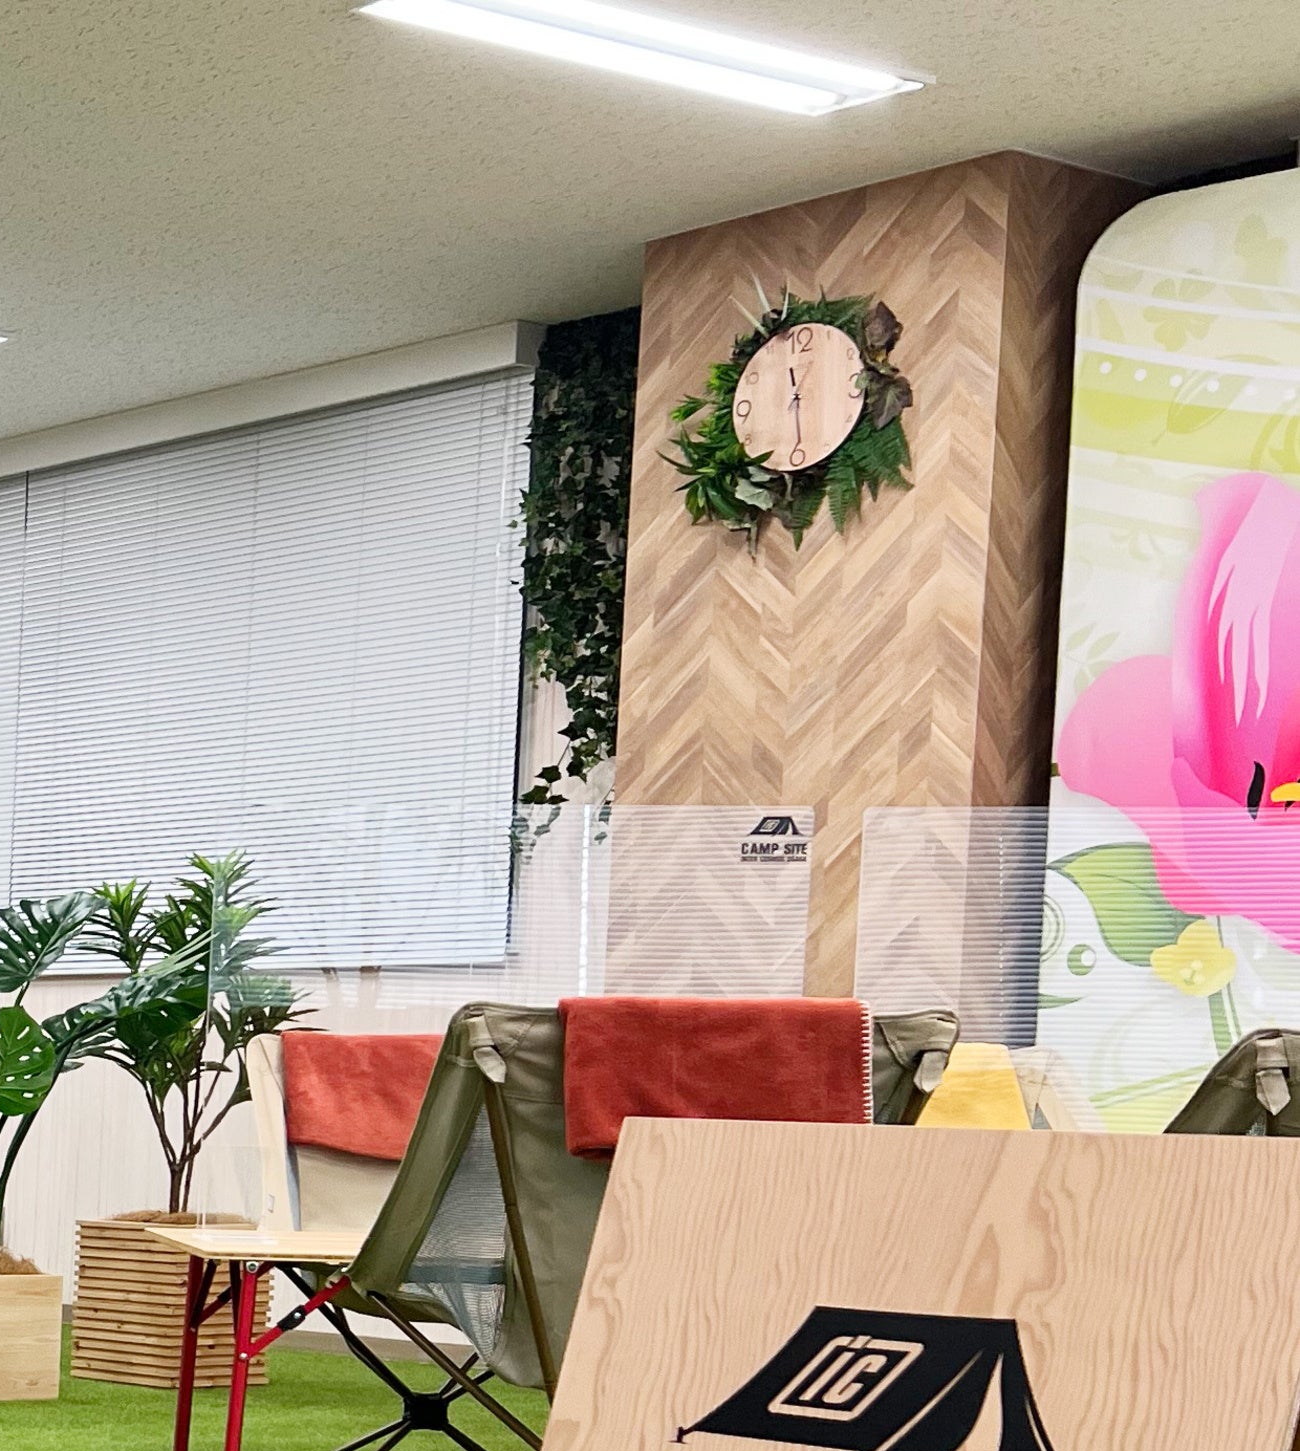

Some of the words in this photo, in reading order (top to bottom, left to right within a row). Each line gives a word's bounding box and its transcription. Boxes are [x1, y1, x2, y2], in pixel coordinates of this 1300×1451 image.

[785, 327, 813, 354] 12
[736, 399, 753, 425] 9
[789, 441, 806, 467] 6
[741, 842, 779, 855] CAMP
[783, 843, 808, 855] SITE
